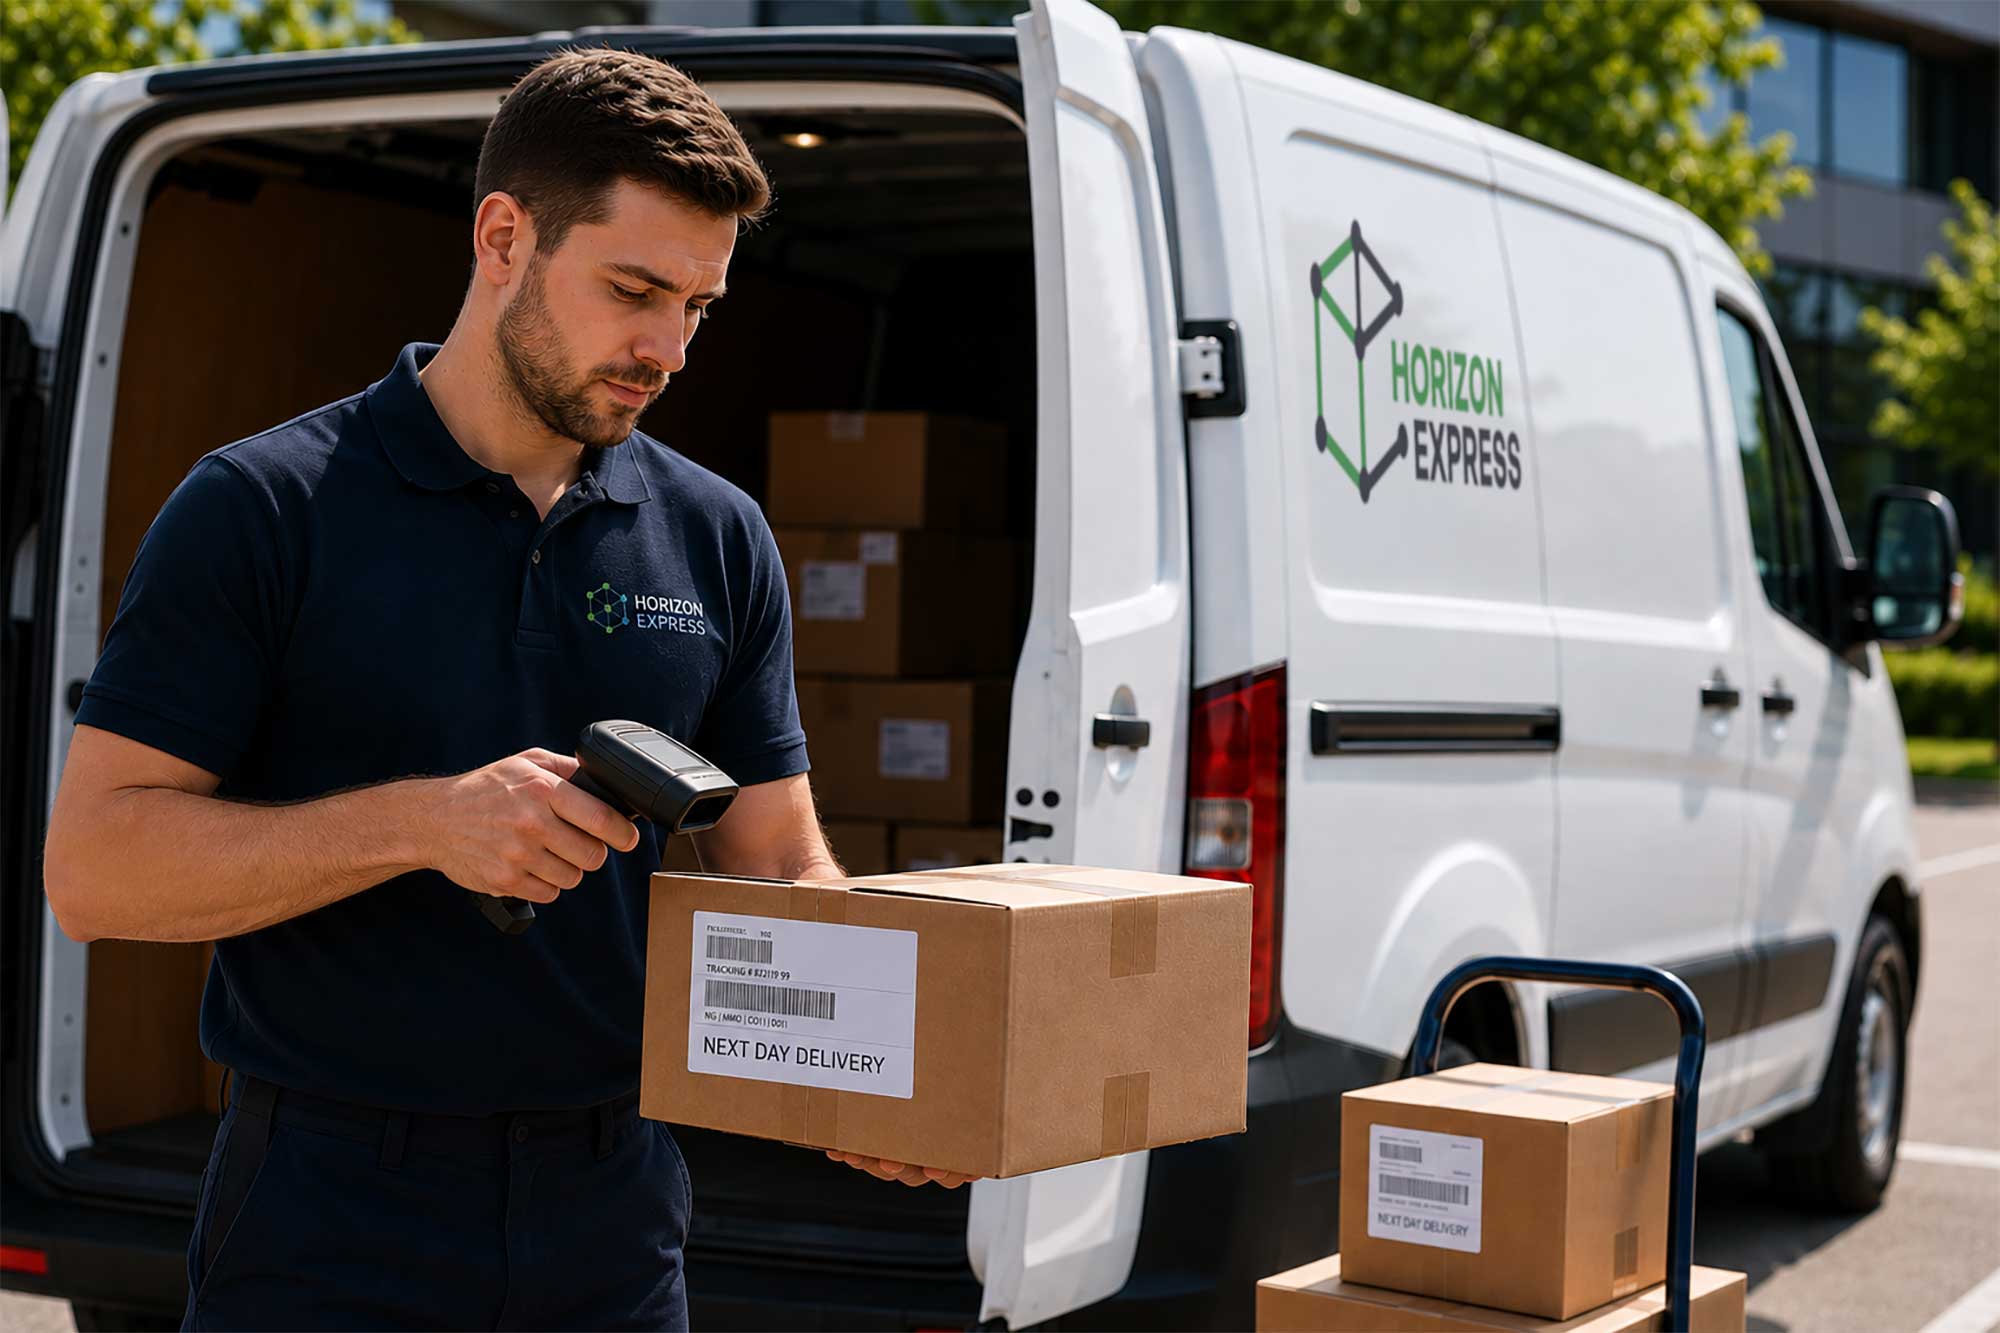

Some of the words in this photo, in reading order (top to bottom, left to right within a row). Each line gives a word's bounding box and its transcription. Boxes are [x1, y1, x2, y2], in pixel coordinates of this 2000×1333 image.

[1391, 339, 1504, 418] HORIZON
[1413, 418, 1522, 490] EXPRESS
[634, 594, 704, 618] HORIZON
[636, 613, 706, 636] EXPRESS
[706, 964, 746, 976] TRACKING
[703, 1036, 750, 1057] NEXT
[755, 1042, 791, 1063] DAY
[796, 1047, 885, 1074] DELIVERY
[1377, 1212, 1402, 1226] NEXT
[1403, 1216, 1422, 1230] DAY
[1423, 1219, 1469, 1237] DELIVERY
